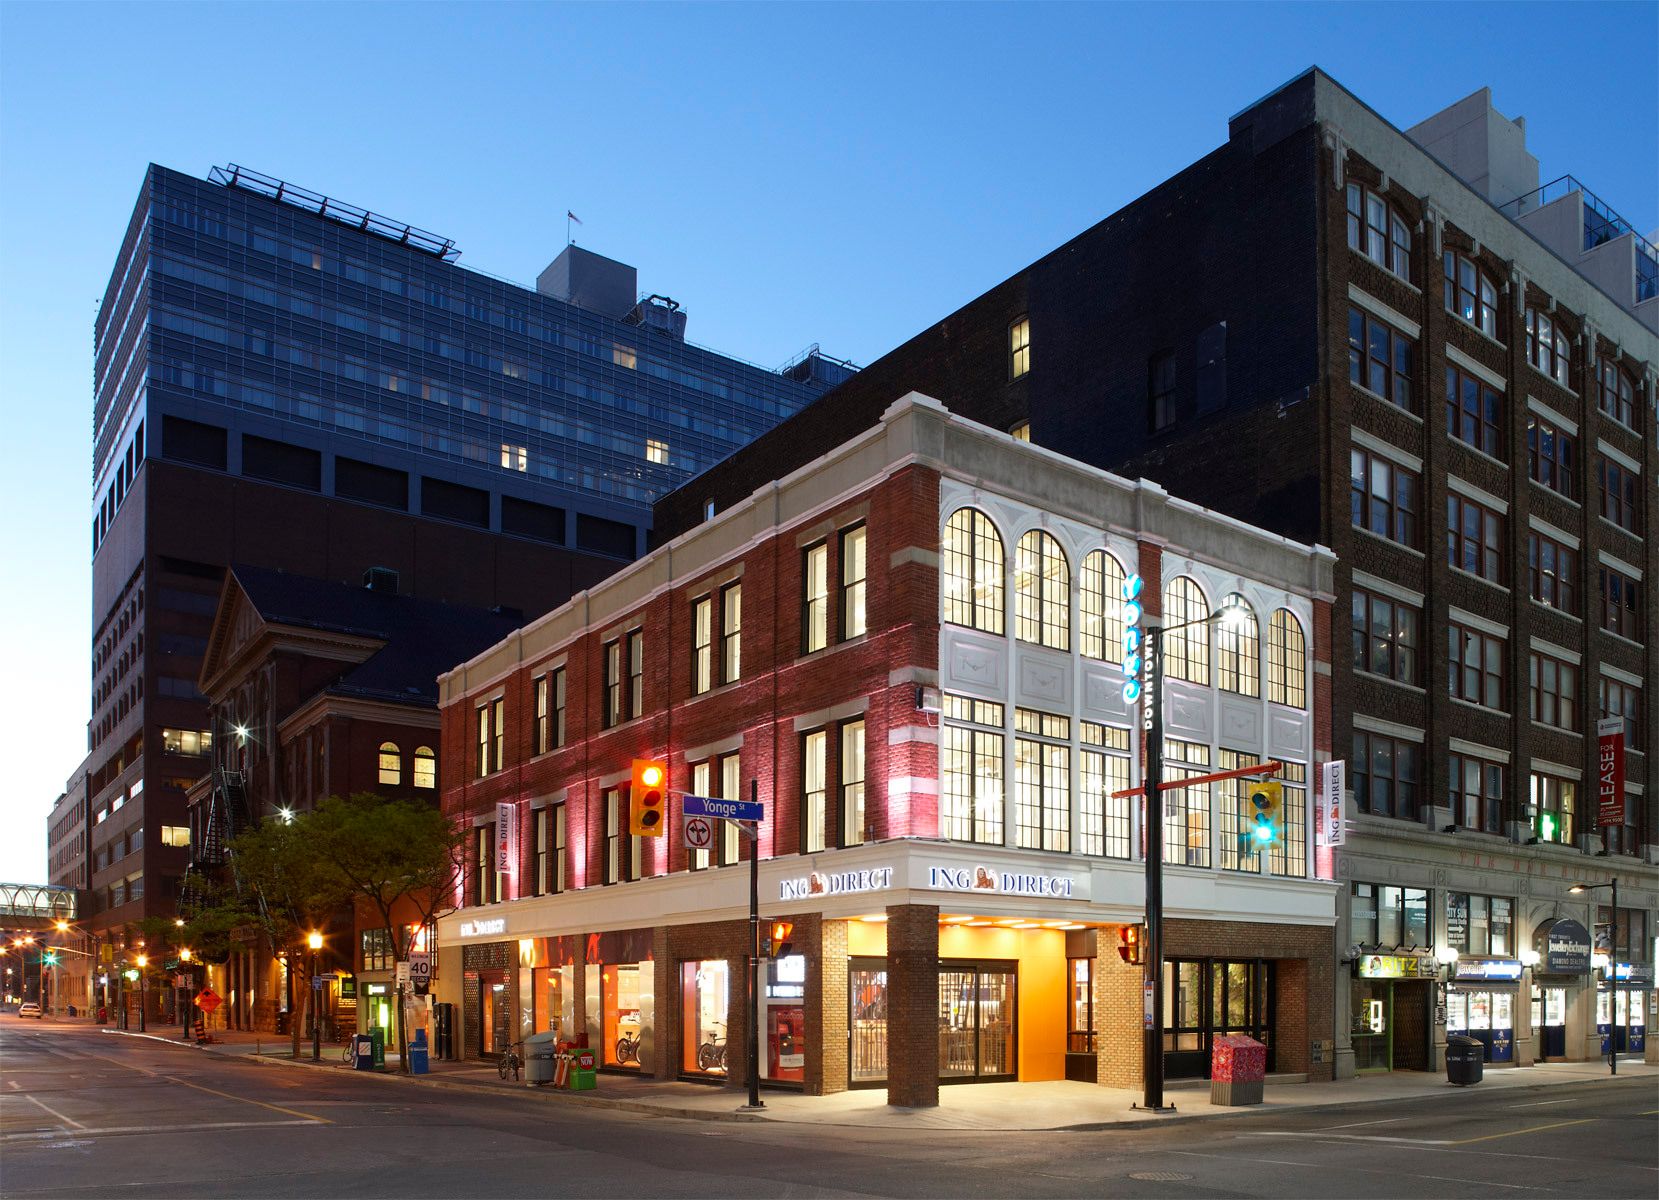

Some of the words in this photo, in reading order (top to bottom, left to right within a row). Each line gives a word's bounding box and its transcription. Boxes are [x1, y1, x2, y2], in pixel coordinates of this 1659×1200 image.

[1144, 634, 1153, 730] DOWNTOWN
[1600, 744, 1614, 752] FOR
[1331, 764, 1340, 805] DIRECT
[1600, 752, 1614, 805] LEASE
[703, 799, 737, 817] Yonge
[738, 803, 746, 811] St
[500, 804, 508, 839] DIRECT
[1331, 821, 1340, 842] ING
[500, 852, 508, 870] ING
[779, 878, 808, 900] ING
[828, 867, 893, 895] DIRECT
[929, 867, 970, 890] ING
[1001, 872, 1074, 898] DIRECT
[411, 962, 429, 974] 40
[1382, 957, 1417, 971] RITZ
[580, 1056, 593, 1066] NOW
